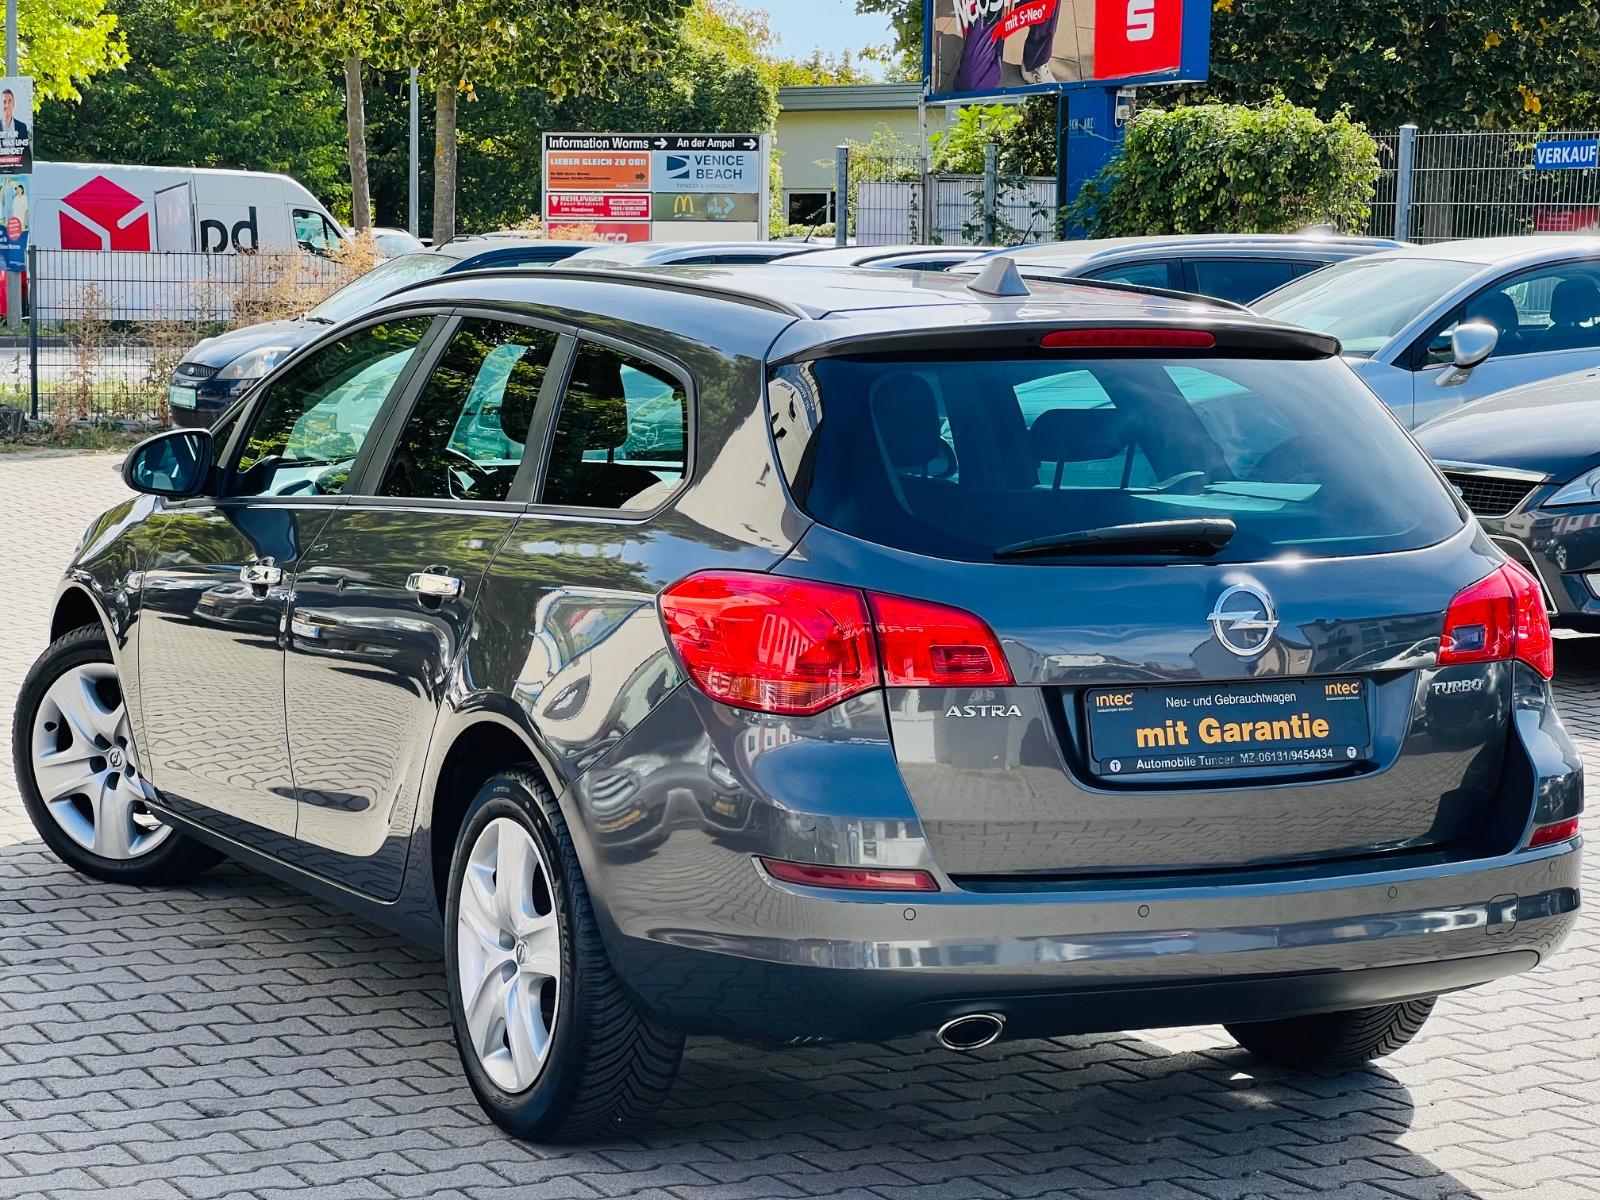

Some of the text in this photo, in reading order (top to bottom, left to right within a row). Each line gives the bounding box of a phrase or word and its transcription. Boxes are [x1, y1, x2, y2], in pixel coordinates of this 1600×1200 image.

[1005, 15, 1018, 32] mit
[549, 137, 649, 149] Information Worms
[676, 137, 735, 149] An der Ampel
[695, 155, 744, 166] VENICE
[1537, 145, 1597, 164] VERKAUF
[582, 158, 612, 166] GLEICH
[614, 158, 626, 166] ZU
[696, 169, 742, 179] BEACH
[1325, 683, 1359, 695] intec
[1432, 678, 1484, 695] TURBO
[1096, 693, 1133, 707] intec
[1166, 693, 1297, 708] Neu- und Gebrauchtwagen
[945, 704, 1022, 717] ASTRA
[1136, 712, 1330, 748] mit Garantie
[1136, 757, 1196, 770] Automobile
